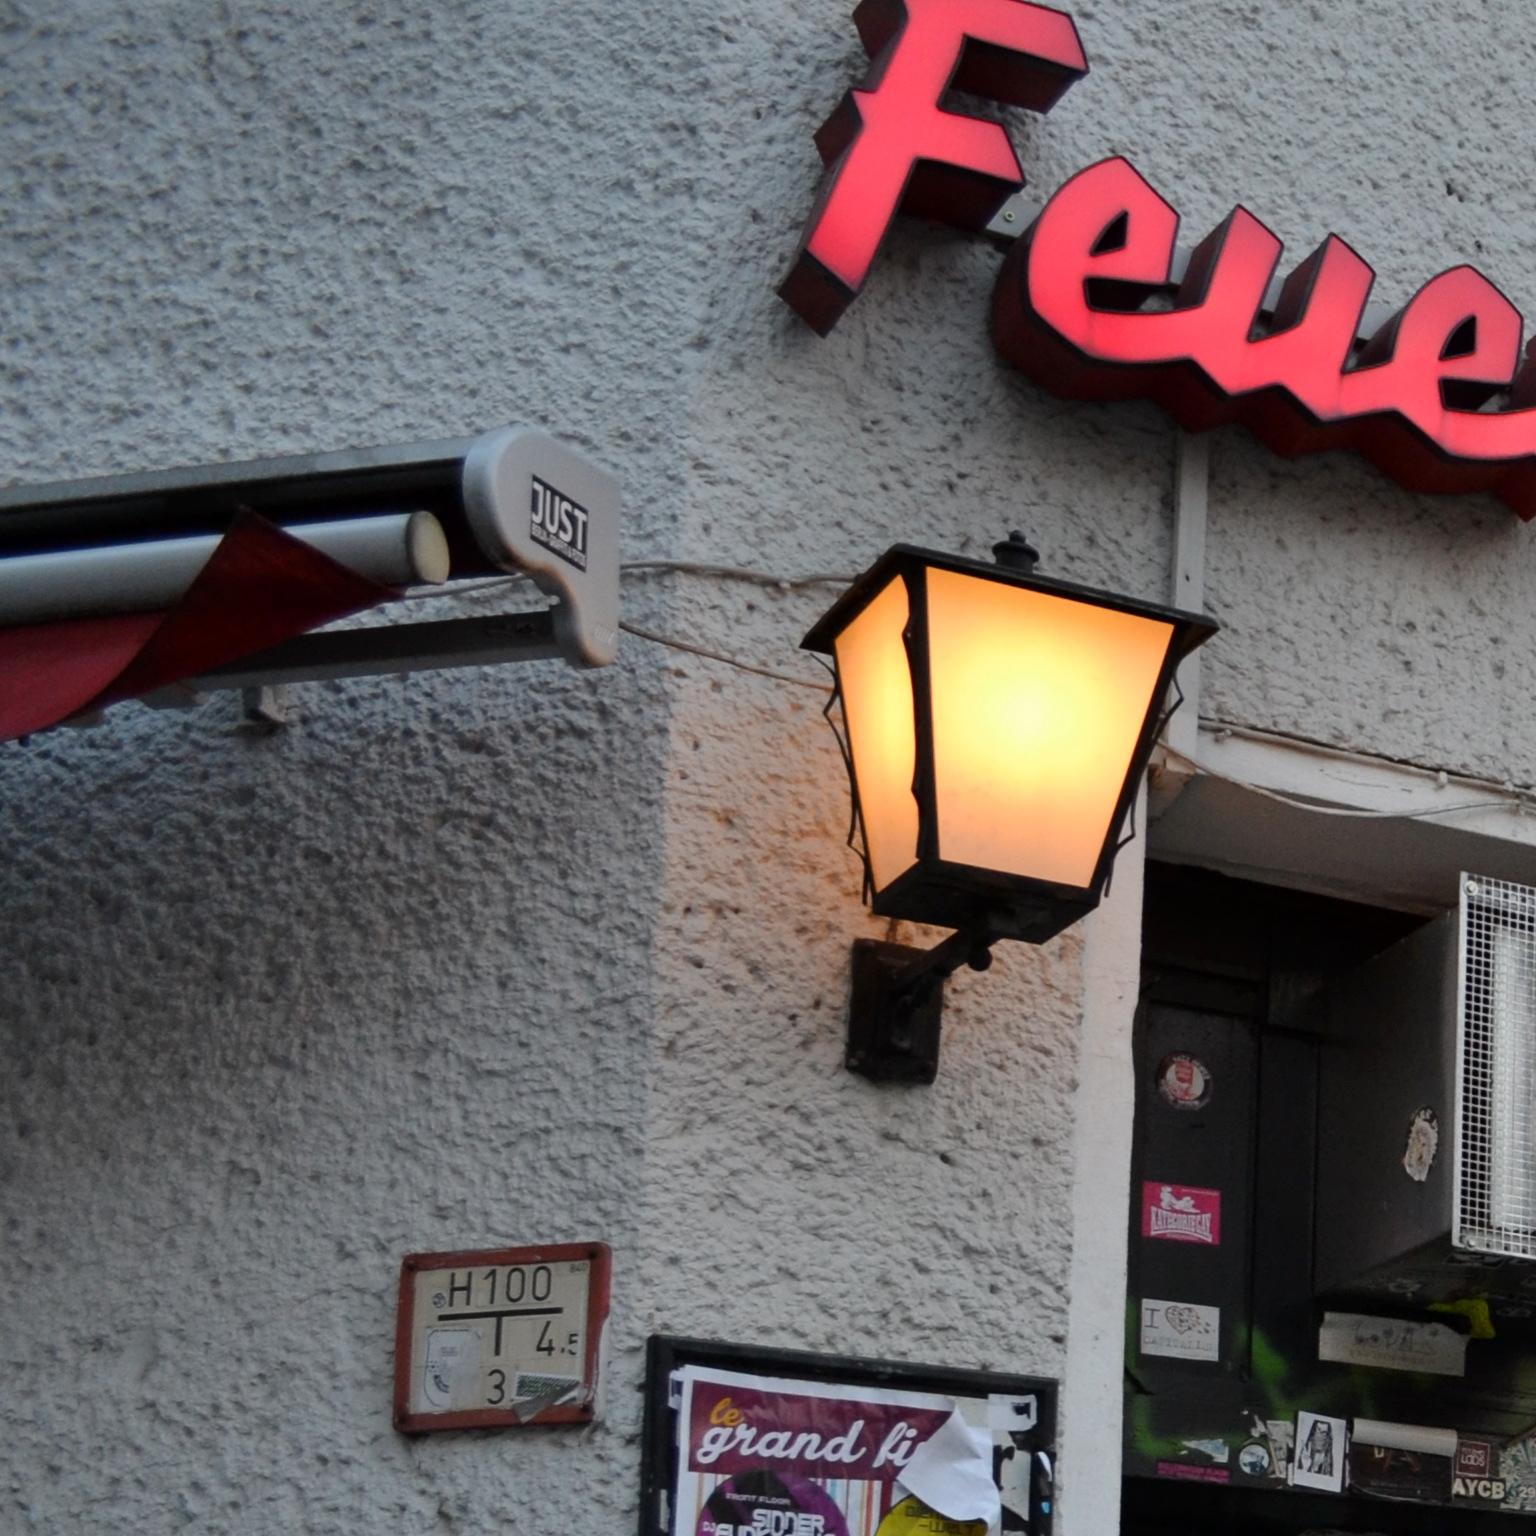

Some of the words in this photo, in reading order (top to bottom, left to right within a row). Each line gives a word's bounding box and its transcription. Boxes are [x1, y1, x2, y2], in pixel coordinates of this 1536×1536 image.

[532, 481, 587, 551] JUST
[449, 1265, 552, 1307] H100
[487, 1369, 506, 1405] 3
[710, 1397, 744, 1427] le
[697, 1420, 866, 1464] grand
[752, 1508, 825, 1533] SINNER
